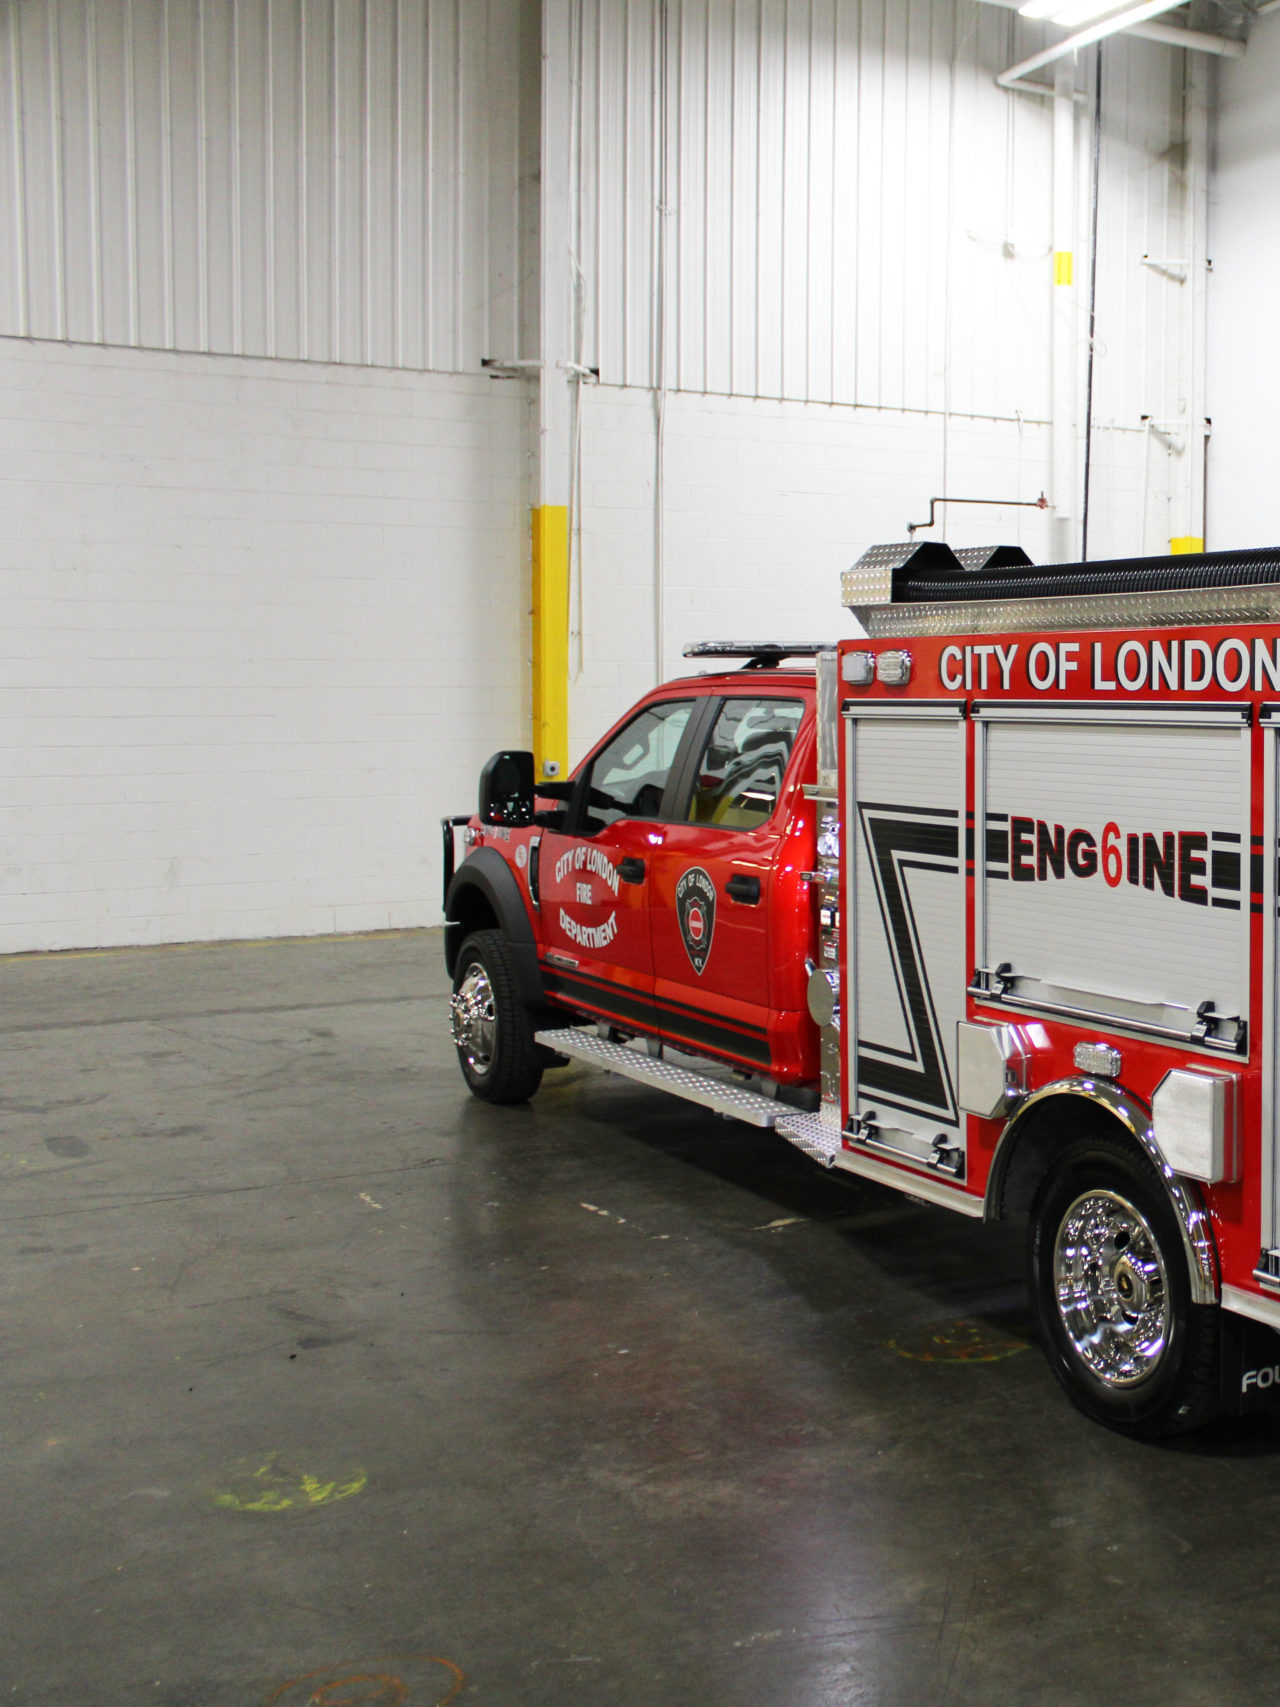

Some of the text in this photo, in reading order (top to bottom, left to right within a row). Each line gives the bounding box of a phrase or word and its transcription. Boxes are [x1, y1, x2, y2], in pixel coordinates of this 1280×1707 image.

[939, 643, 1019, 692] CITY
[1026, 642, 1080, 692] OF
[555, 846, 620, 897] CITY OF LONDON
[1010, 815, 1209, 907] ENG6INE
[576, 882, 592, 905] FIRE
[677, 873, 715, 902] CITY OF LONDON
[559, 907, 618, 949] DEPARTMENT
